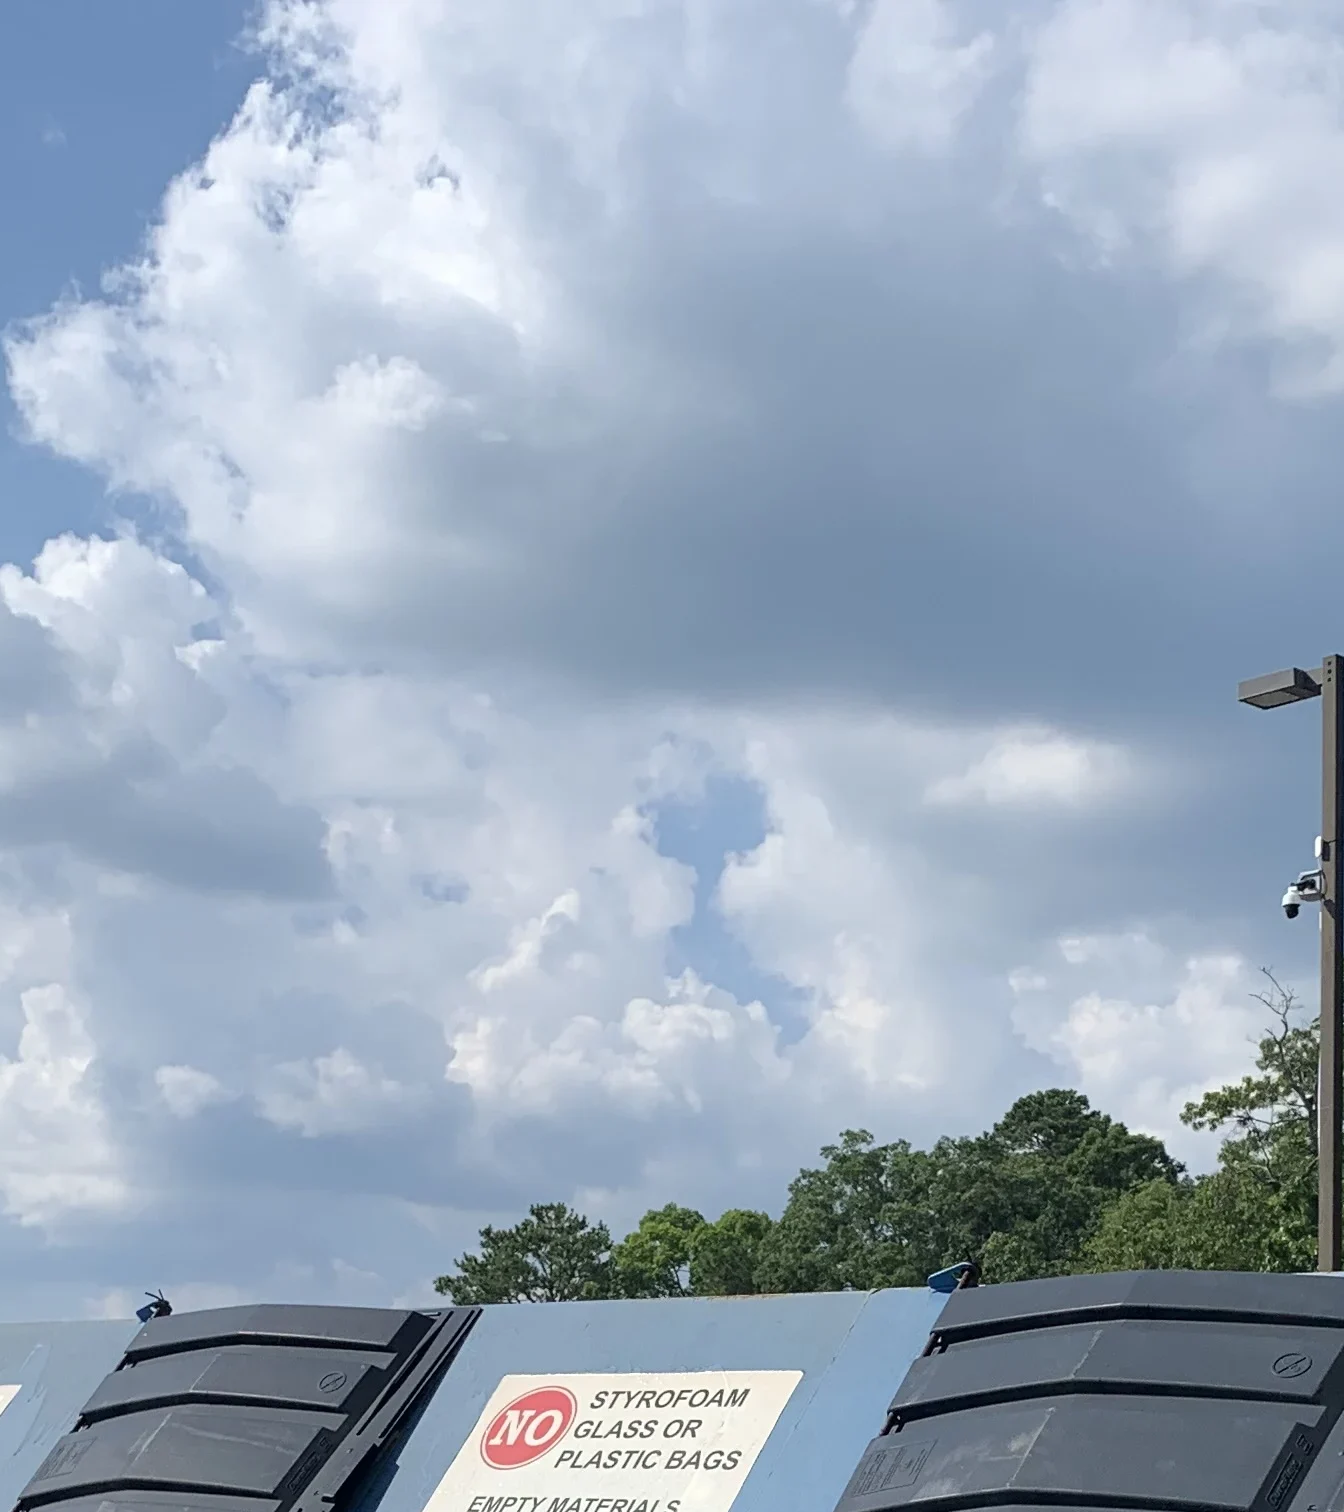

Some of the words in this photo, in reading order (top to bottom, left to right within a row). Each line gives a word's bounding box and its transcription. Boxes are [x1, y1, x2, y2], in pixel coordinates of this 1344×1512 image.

[589, 1388, 751, 1410] STYROFOAM
[488, 1410, 563, 1446] NO
[573, 1419, 656, 1439] GLASS
[662, 1418, 702, 1439] OR
[554, 1450, 663, 1470] PLASTIC
[664, 1450, 743, 1470] BAGS
